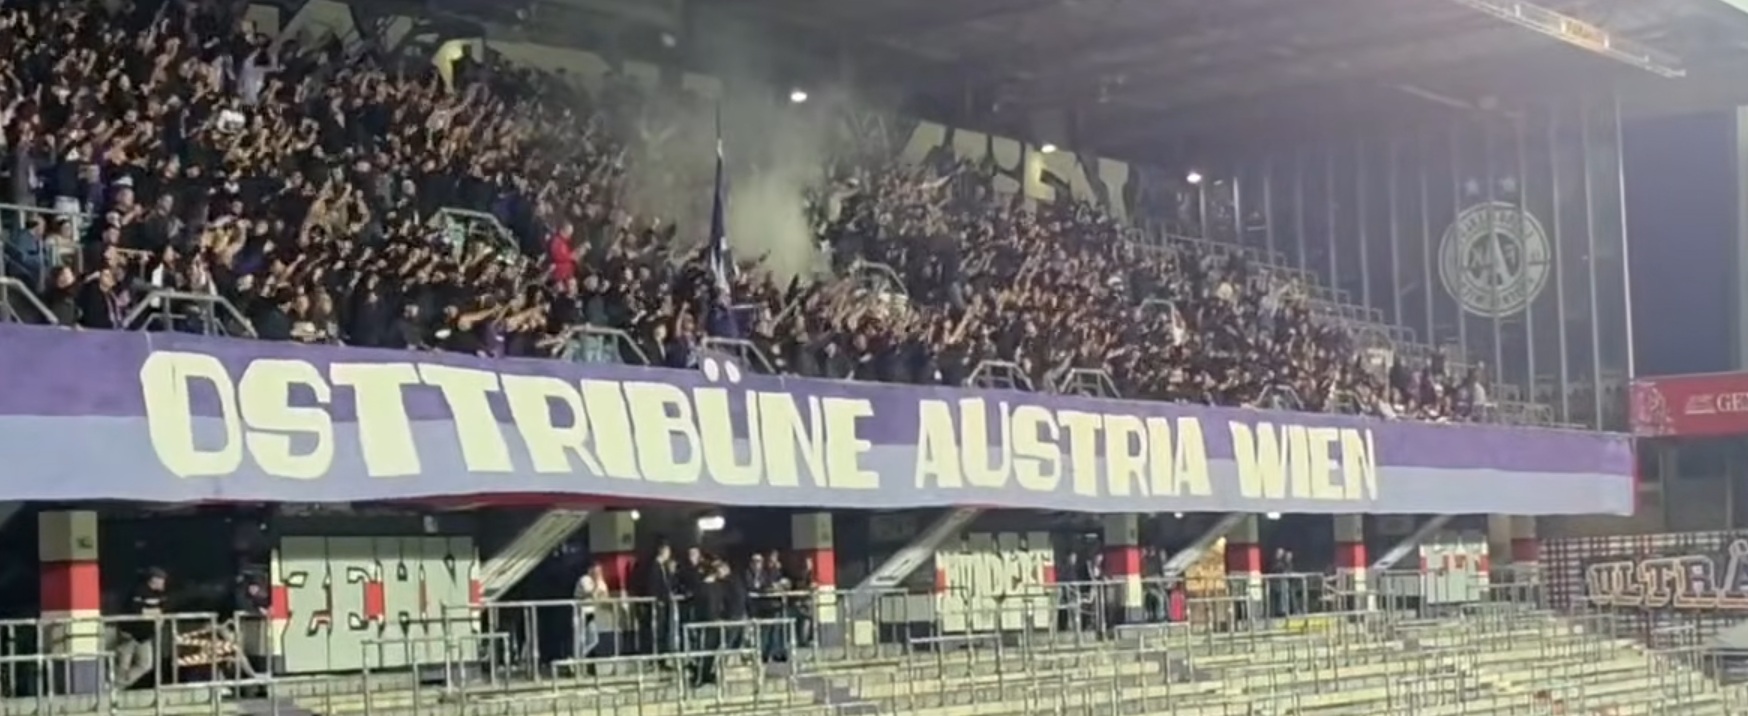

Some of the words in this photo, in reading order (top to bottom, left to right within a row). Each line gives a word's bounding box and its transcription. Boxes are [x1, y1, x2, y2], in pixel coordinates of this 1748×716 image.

[140, 350, 880, 490] OSTTRIBÜNE
[914, 397, 1213, 497] AUSTRIA
[1229, 420, 1378, 501] WIEN
[1716, 391, 1748, 412] GE
[280, 536, 478, 672] ZEHN
